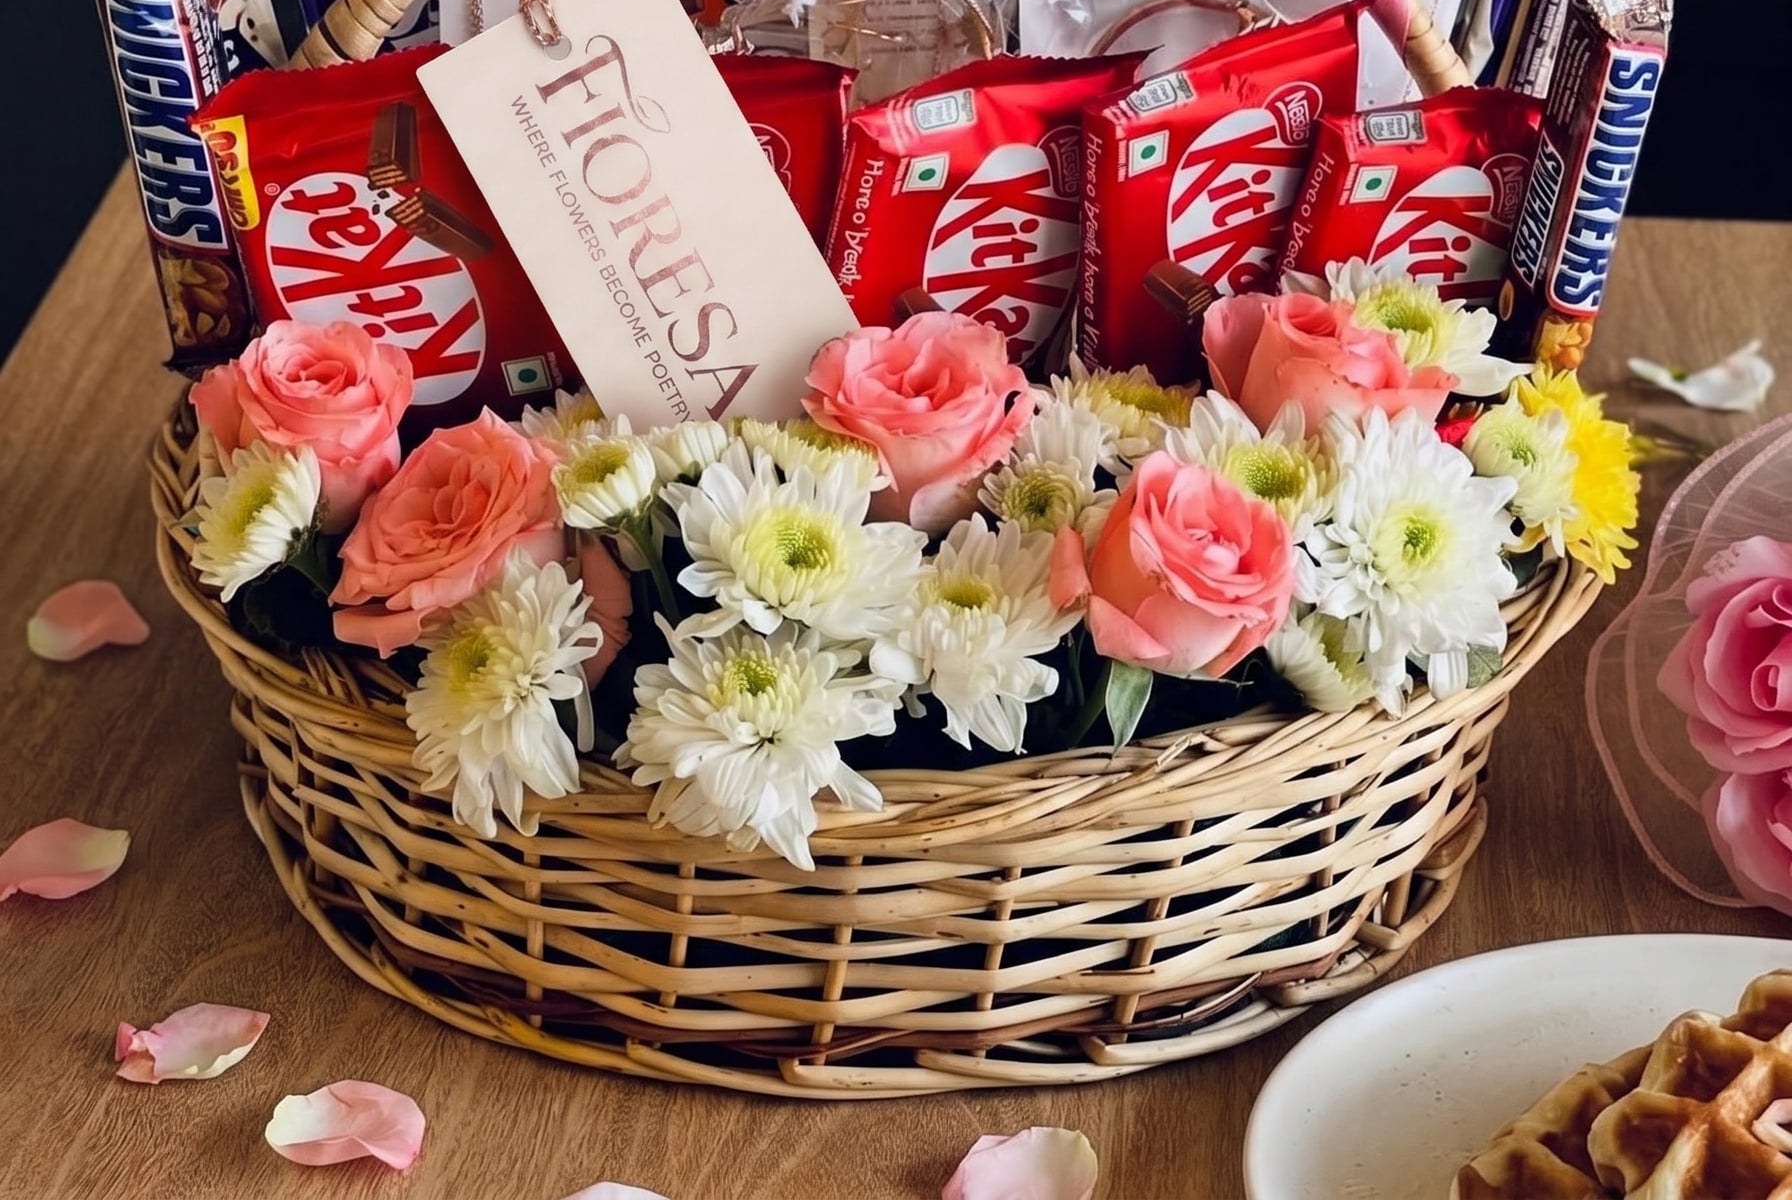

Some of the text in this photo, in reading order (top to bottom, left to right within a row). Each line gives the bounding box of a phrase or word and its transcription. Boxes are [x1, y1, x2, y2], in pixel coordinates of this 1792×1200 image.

[510, 93, 696, 424] WHERE FLOWERS BECOME POETRY
[536, 33, 760, 422] FIORESA
[1513, 137, 1563, 287] SNICKERS
[1548, 57, 1659, 307] SNICKERS
